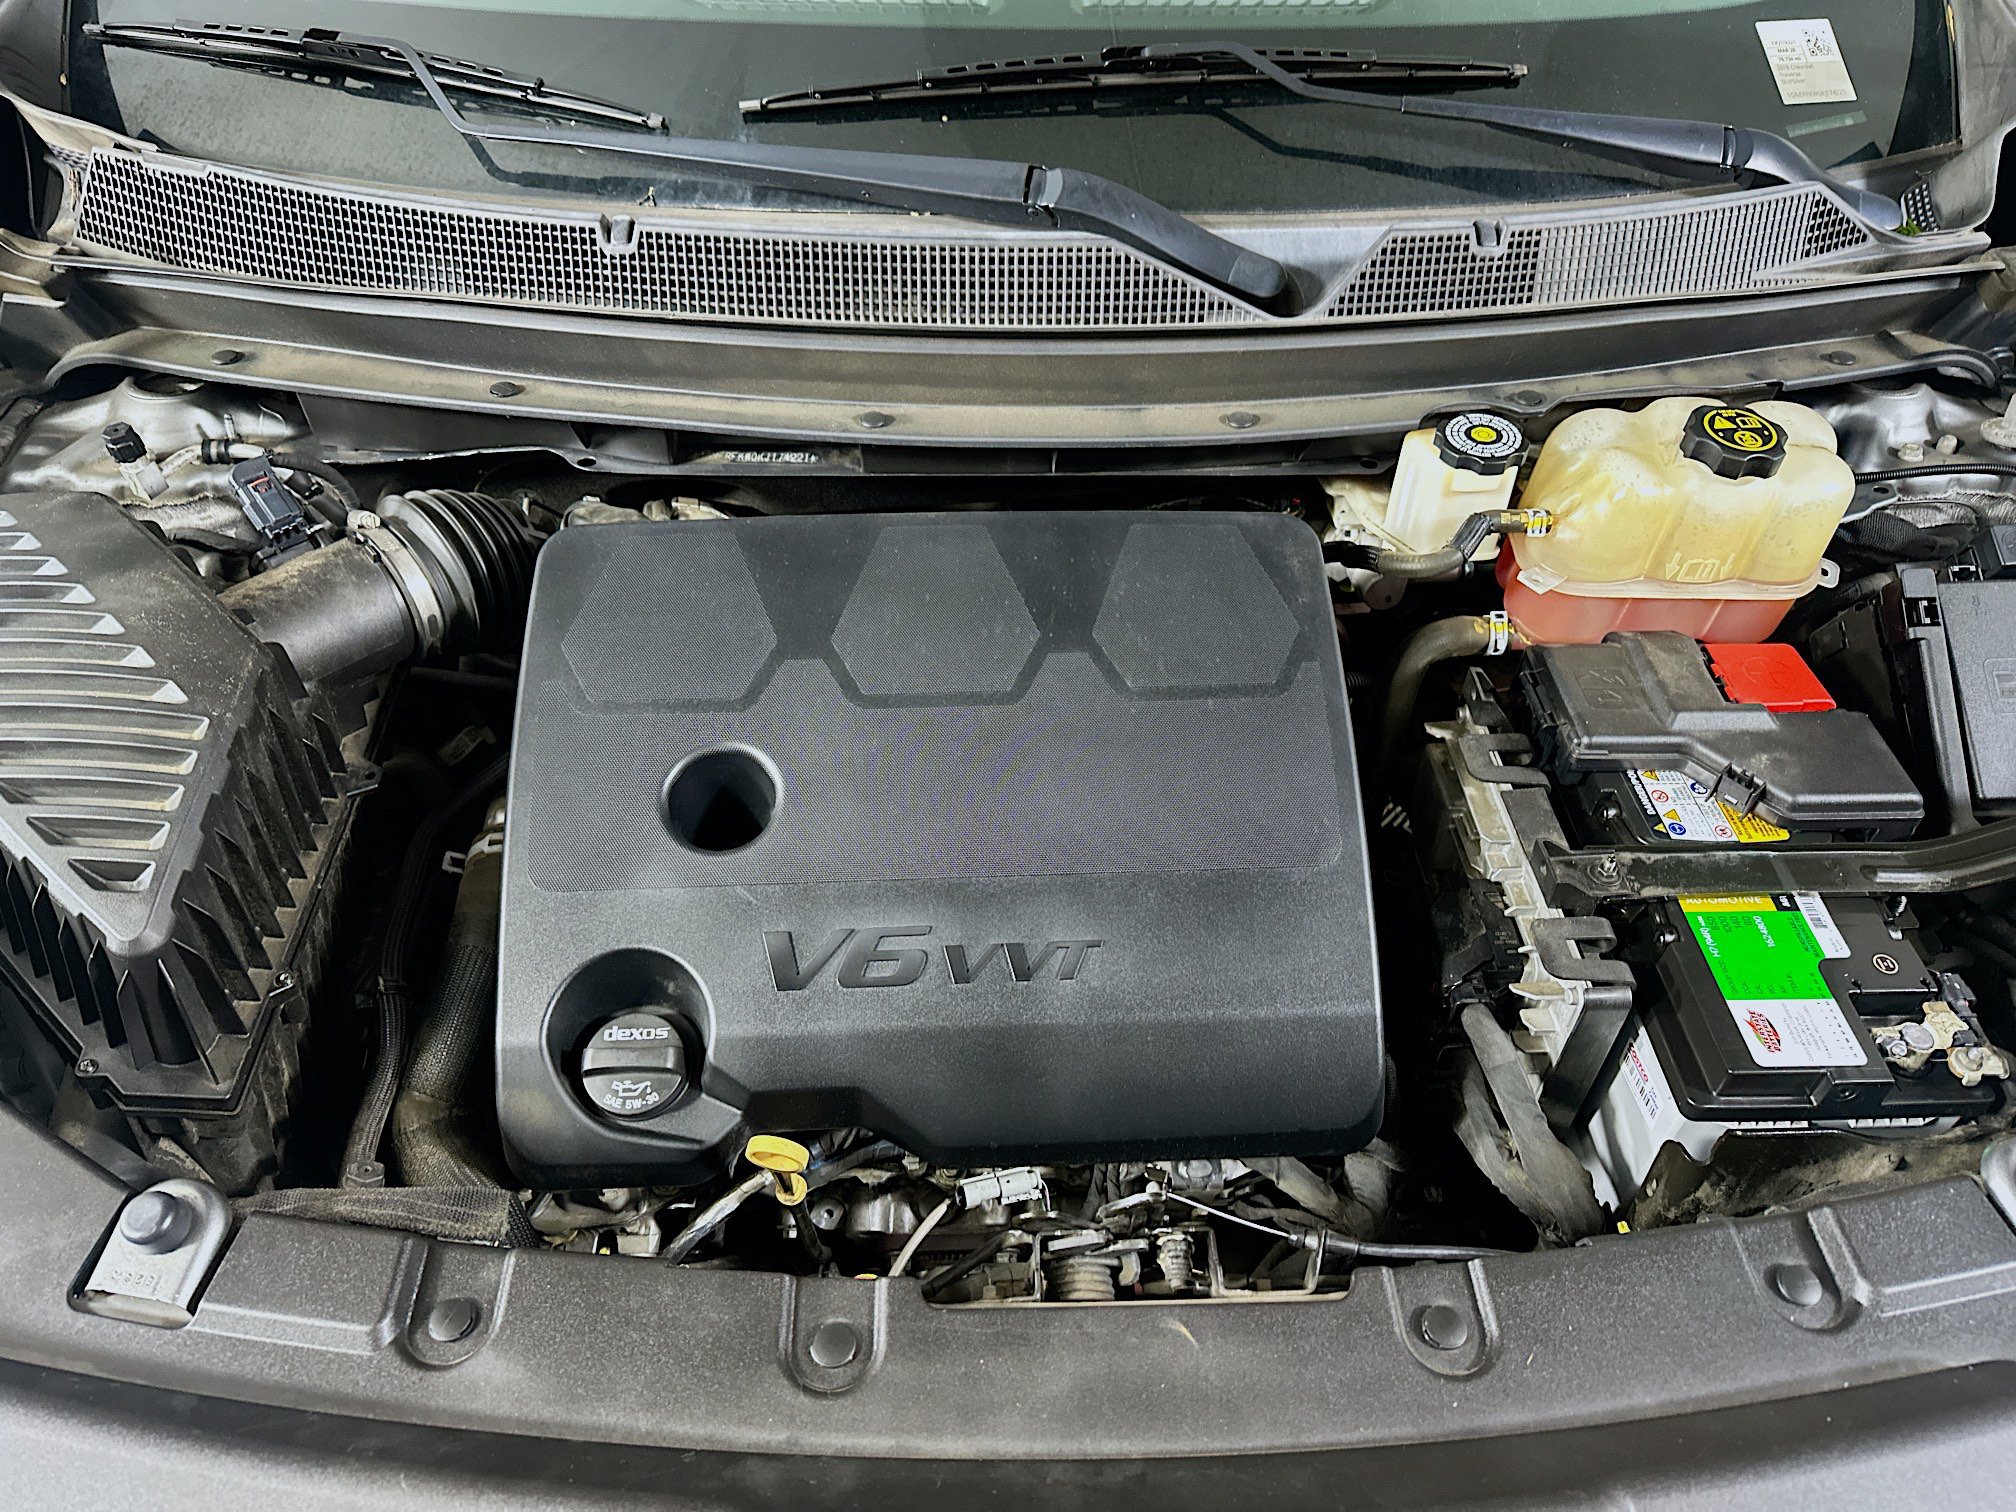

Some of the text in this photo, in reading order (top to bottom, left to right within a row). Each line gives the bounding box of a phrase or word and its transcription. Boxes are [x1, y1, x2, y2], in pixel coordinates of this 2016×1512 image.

[1706, 915, 1720, 931] 850
[1717, 915, 1733, 934] 1000
[1730, 915, 1743, 929] 140
[1752, 915, 1776, 948] 1624800
[763, 925, 1105, 992] V6 VVT
[1708, 946, 1721, 957] H7
[603, 1025, 671, 1042] dexos
[1748, 1009, 1775, 1053] INTERSTATE
[1756, 1013, 1781, 1052] BATTERIES
[602, 1092, 661, 1110] SAE 5W-30
